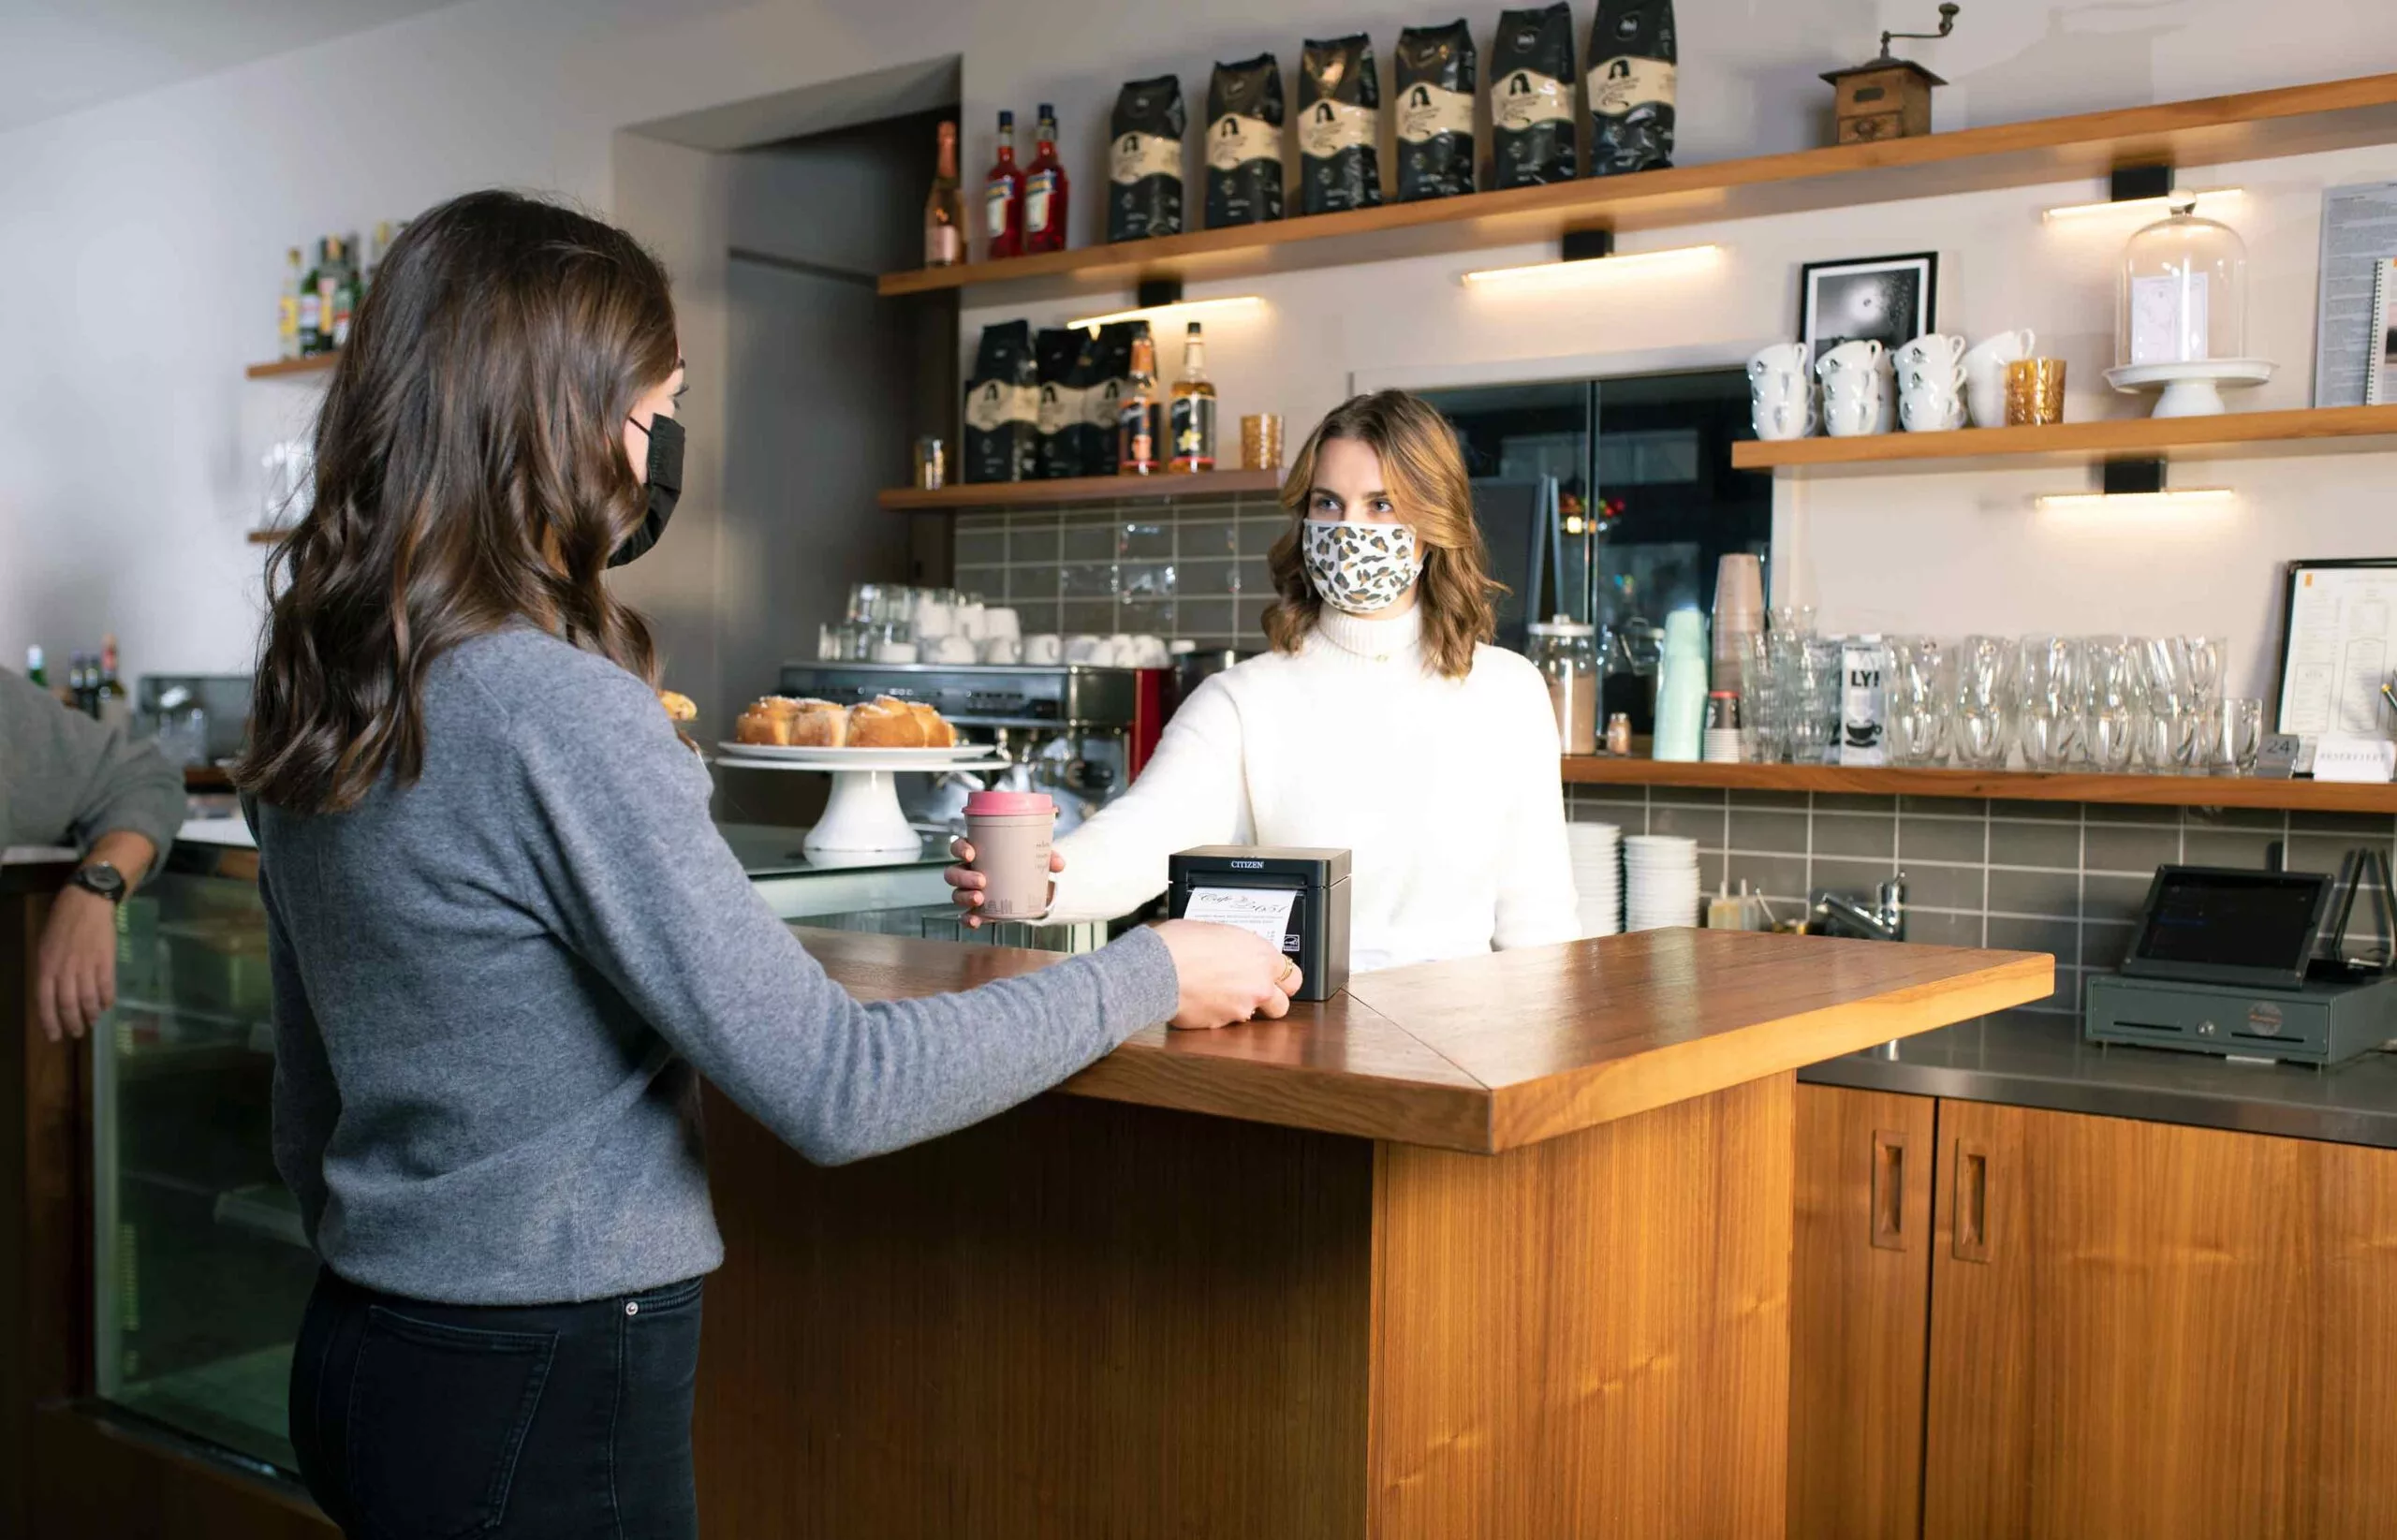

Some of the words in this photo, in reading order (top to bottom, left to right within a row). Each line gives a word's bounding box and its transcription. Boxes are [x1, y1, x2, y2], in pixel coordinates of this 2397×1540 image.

[1850, 670, 1880, 687] LY!
[2266, 740, 2289, 755] 24
[1230, 860, 1264, 869] CITIZEN
